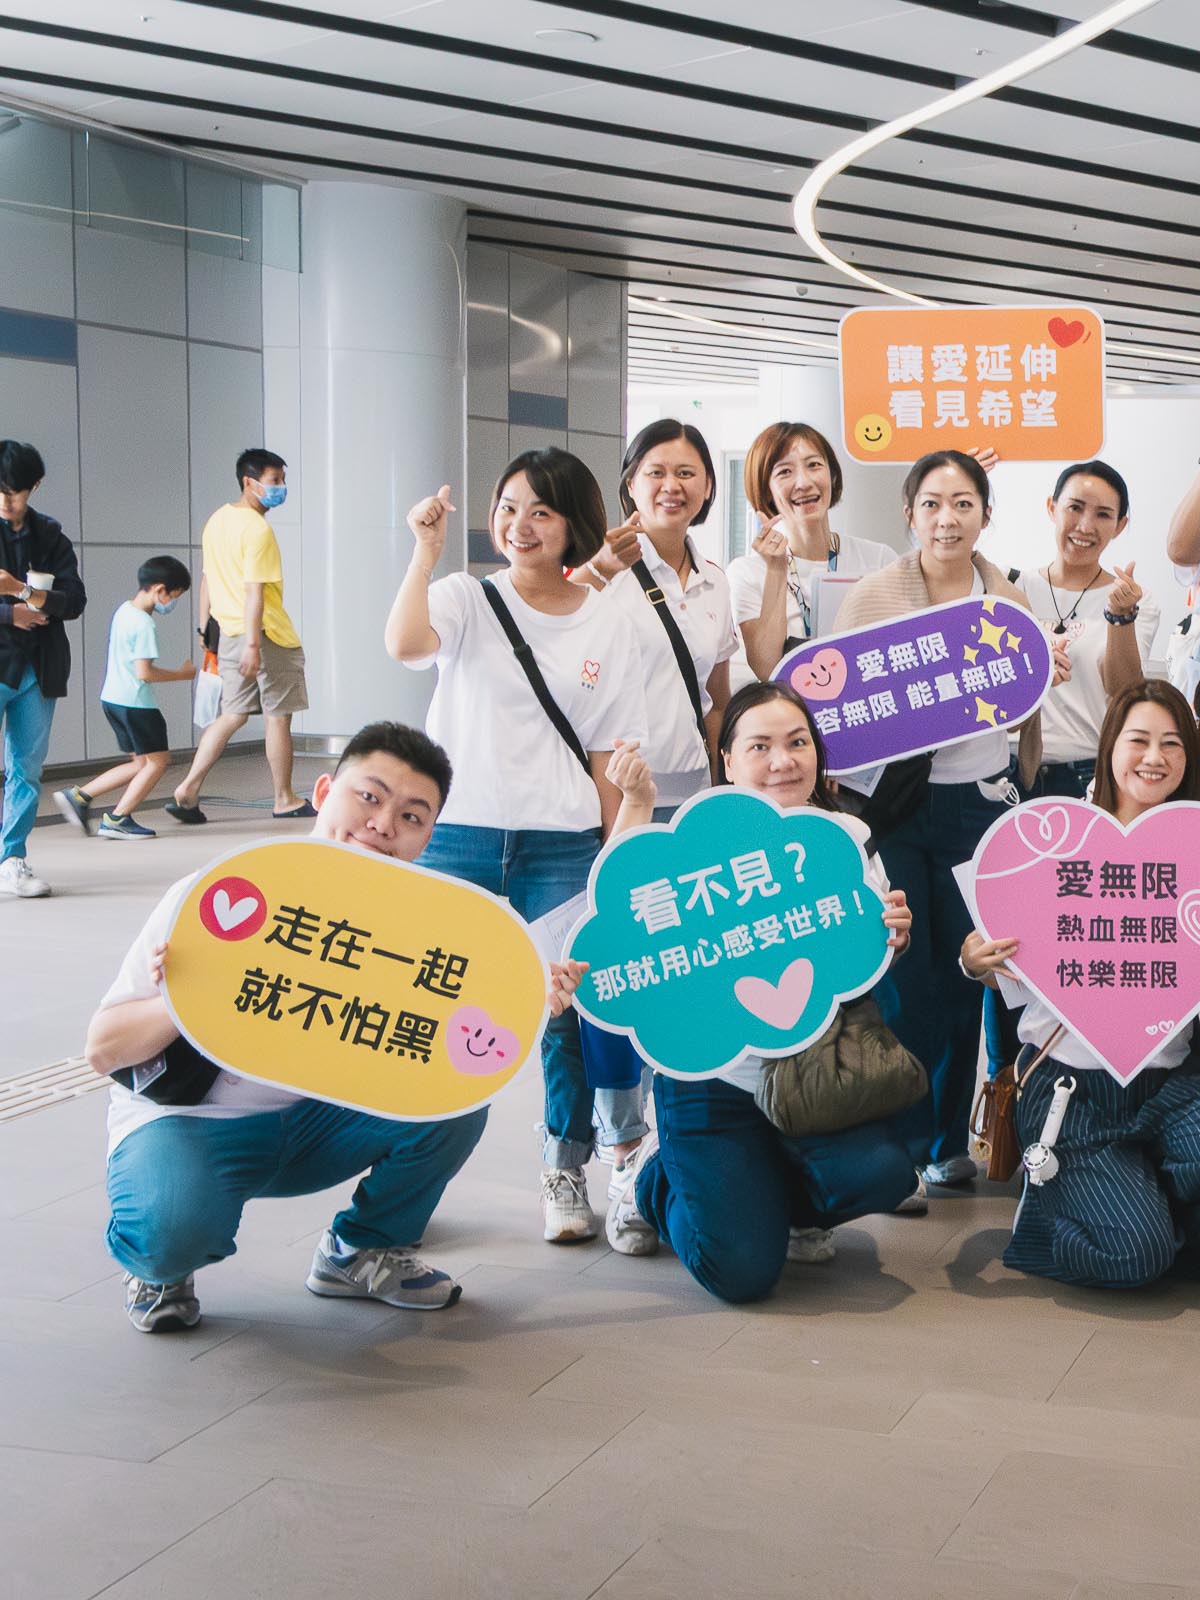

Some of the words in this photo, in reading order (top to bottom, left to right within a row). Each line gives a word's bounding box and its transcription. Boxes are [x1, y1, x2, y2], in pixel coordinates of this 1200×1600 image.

[886, 343, 1057, 384] 讓愛延伸
[888, 389, 1058, 429] 看見希望
[856, 632, 950, 682] 愛無限
[629, 842, 807, 935] 看不見？
[1056, 860, 1178, 900] 愛無限
[1056, 914, 1178, 944] 熱血無限
[264, 905, 469, 1000] 走在一起
[1056, 959, 1178, 989] 快樂無限
[234, 967, 439, 1064] 就不怕黑
